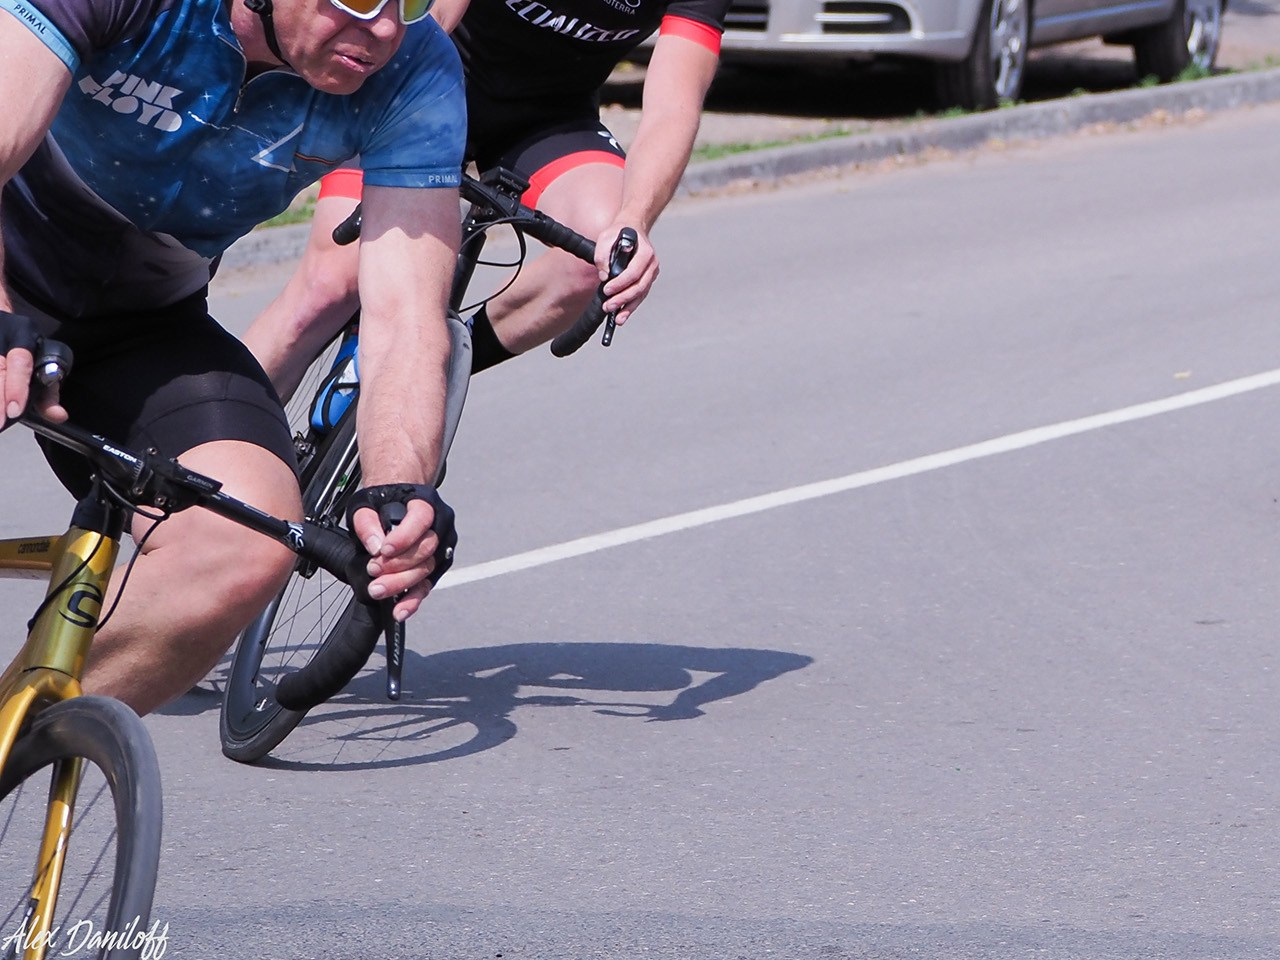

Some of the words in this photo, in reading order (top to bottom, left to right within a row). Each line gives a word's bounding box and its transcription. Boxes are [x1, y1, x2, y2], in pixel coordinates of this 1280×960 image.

[13, 4, 47, 35] PRIMAL
[77, 75, 183, 132] FLOYD
[101, 69, 184, 110] PINK
[102, 444, 137, 463] EASTON
[186, 474, 214, 489] GARMIN
